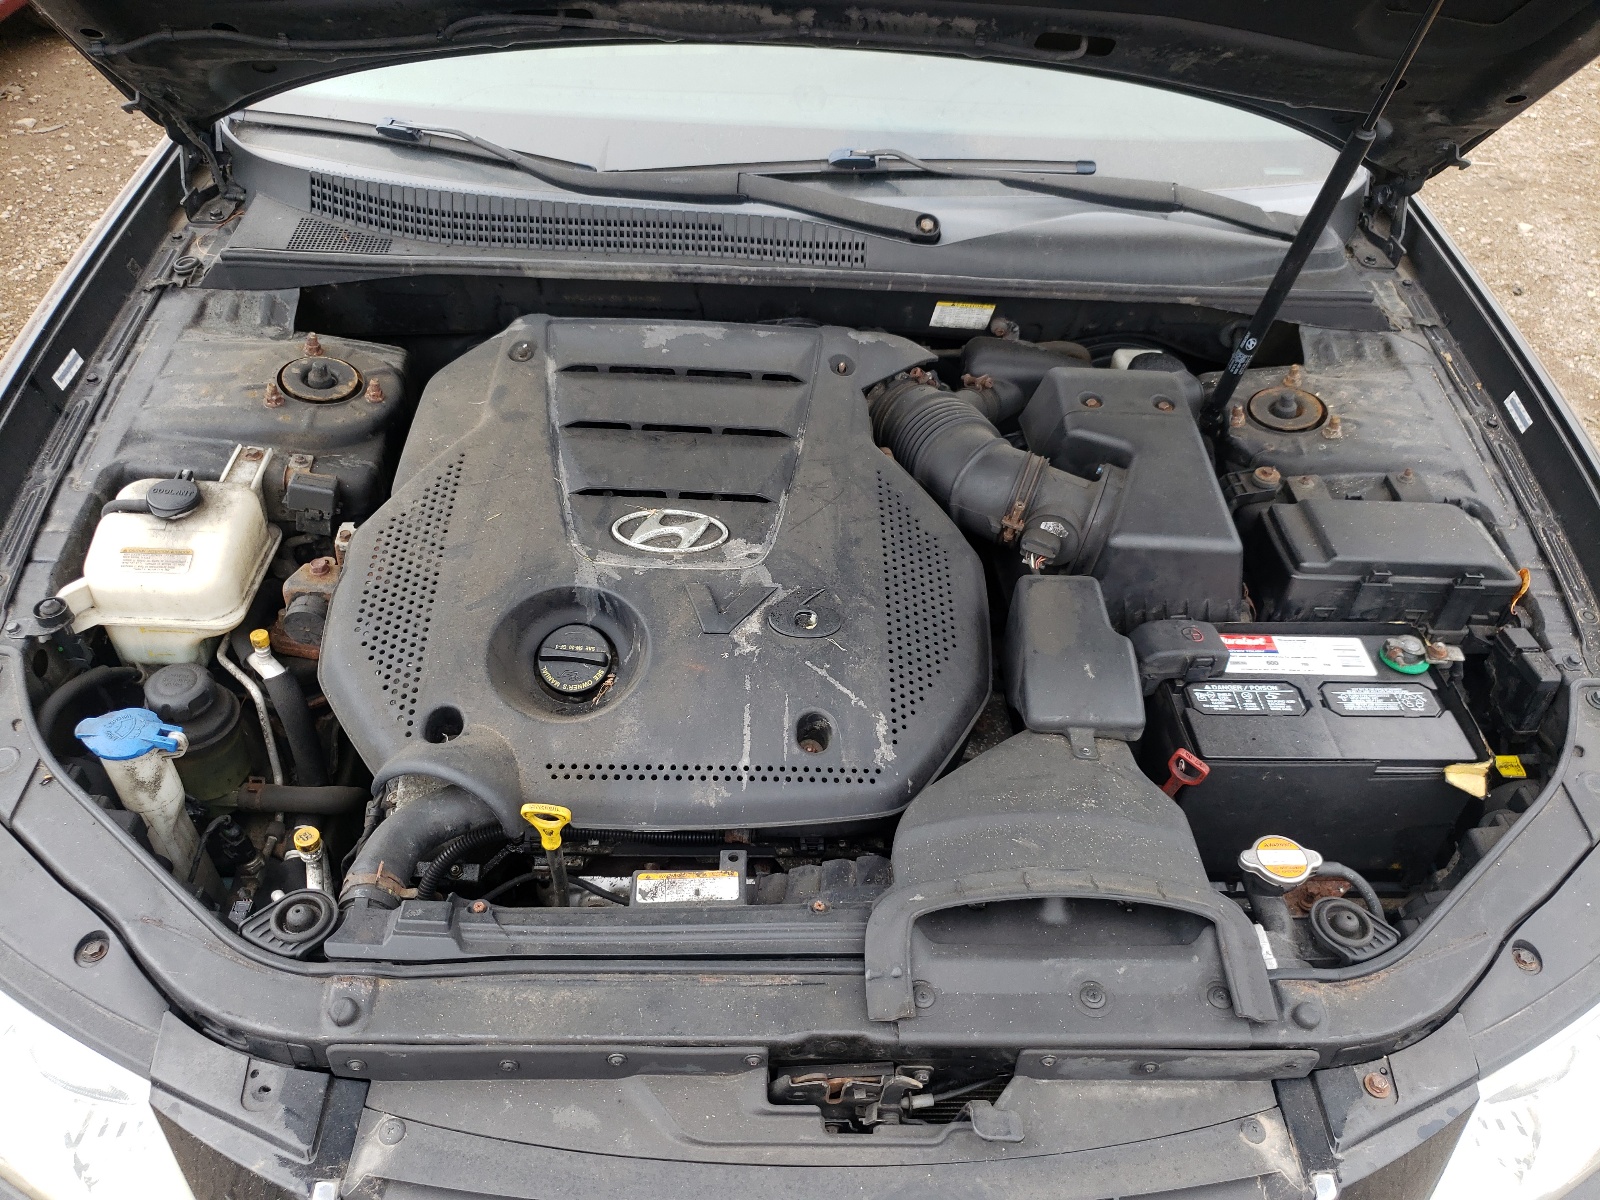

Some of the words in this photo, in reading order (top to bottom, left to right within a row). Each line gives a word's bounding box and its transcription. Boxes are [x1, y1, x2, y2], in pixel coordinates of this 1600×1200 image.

[152, 488, 195, 497] COOLANT
[683, 581, 842, 638] V6
[541, 665, 561, 688] MANUAL
[593, 669, 605, 682] SEE
[562, 679, 593, 691] OWNER'S
